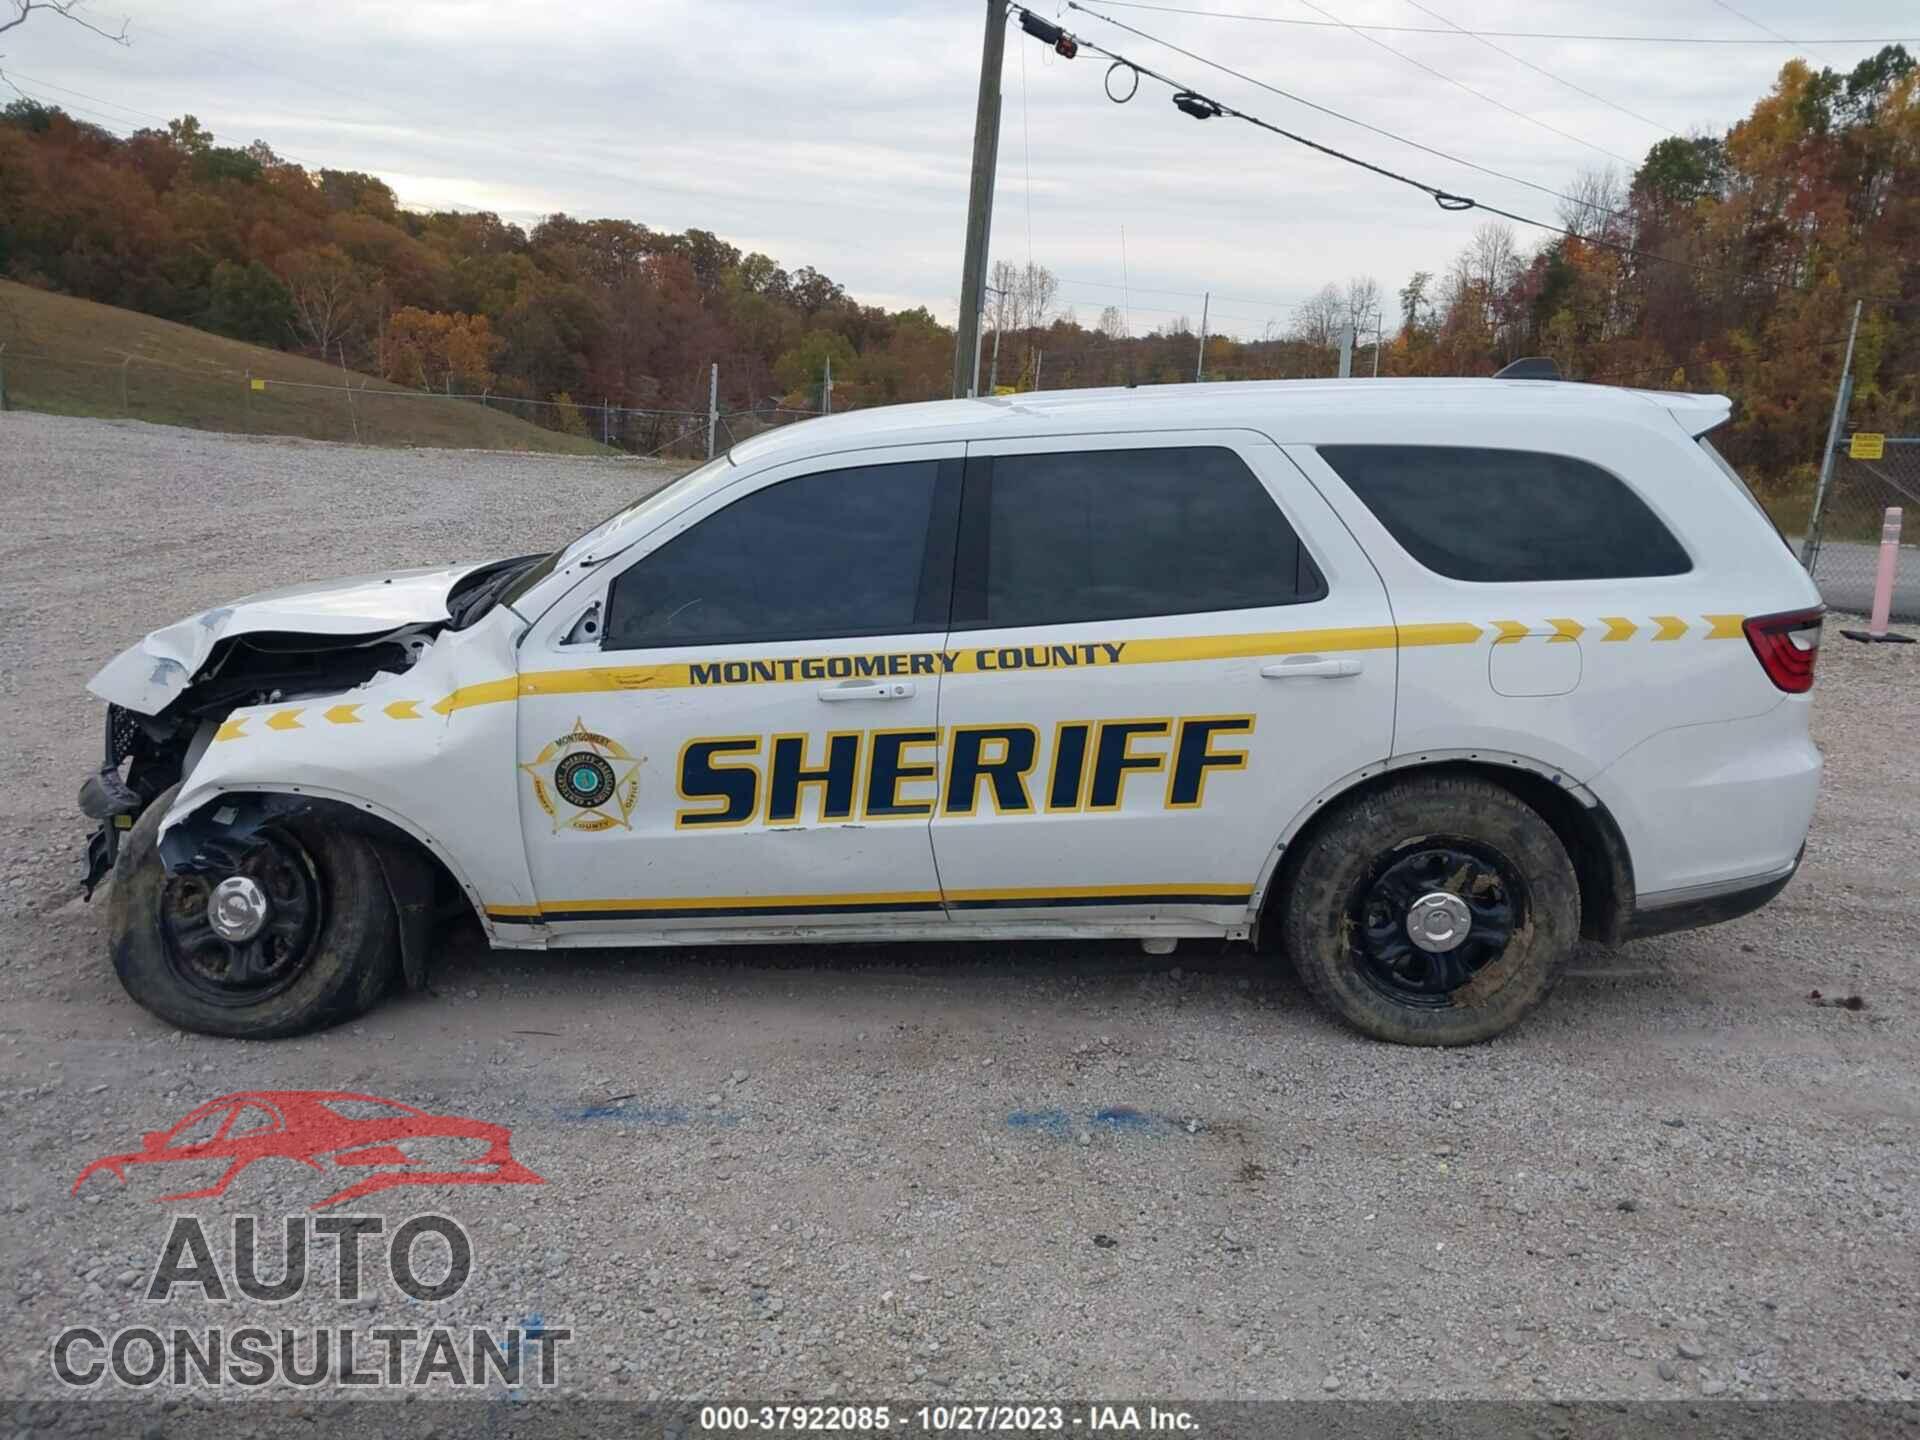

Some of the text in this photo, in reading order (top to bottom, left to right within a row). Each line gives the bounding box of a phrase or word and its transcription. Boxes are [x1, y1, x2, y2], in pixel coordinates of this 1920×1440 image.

[689, 642, 1126, 685] MONTGOMERY COUNTY
[555, 733, 610, 747] MONTGOMERY
[675, 713, 1257, 829] SHERIFF
